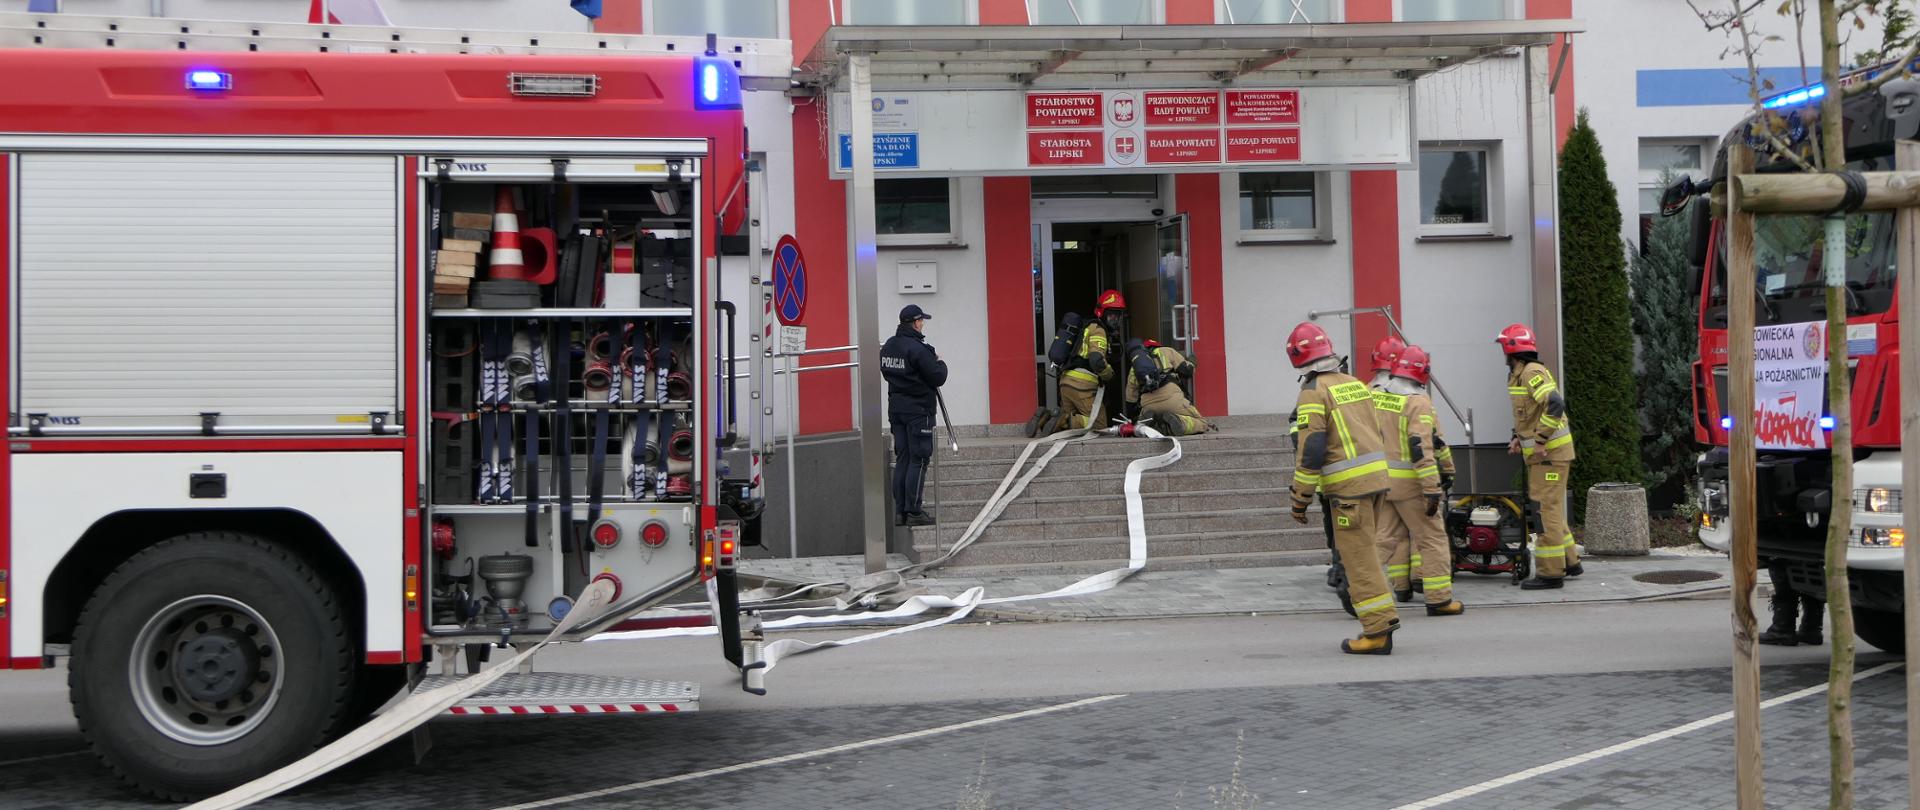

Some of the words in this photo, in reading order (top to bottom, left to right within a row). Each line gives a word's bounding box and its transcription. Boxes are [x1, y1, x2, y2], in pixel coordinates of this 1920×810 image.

[1035, 98, 1095, 106] STAROSTWO
[1147, 96, 1216, 106] PRZEWODNICZĄCY
[1035, 108, 1095, 117] POWIATOWE
[1154, 107, 1176, 115] RADY
[1176, 106, 1211, 115] POWIATU
[1040, 139, 1092, 148] STAROSTA
[1150, 140, 1174, 148] RADA
[1176, 139, 1216, 147] POWIATU
[1229, 138, 1259, 146] ZARZĄD
[1261, 137, 1297, 145] POWIATU
[1049, 150, 1084, 158] LIPSKI
[456, 163, 488, 171] WISS
[881, 357, 905, 369] POLICJA
[484, 361, 495, 401] WISS
[609, 365, 621, 404] WISS
[633, 365, 645, 404] WISS
[657, 367, 669, 404] WISS
[49, 416, 81, 425] WISS
[634, 463, 646, 500] WISS
